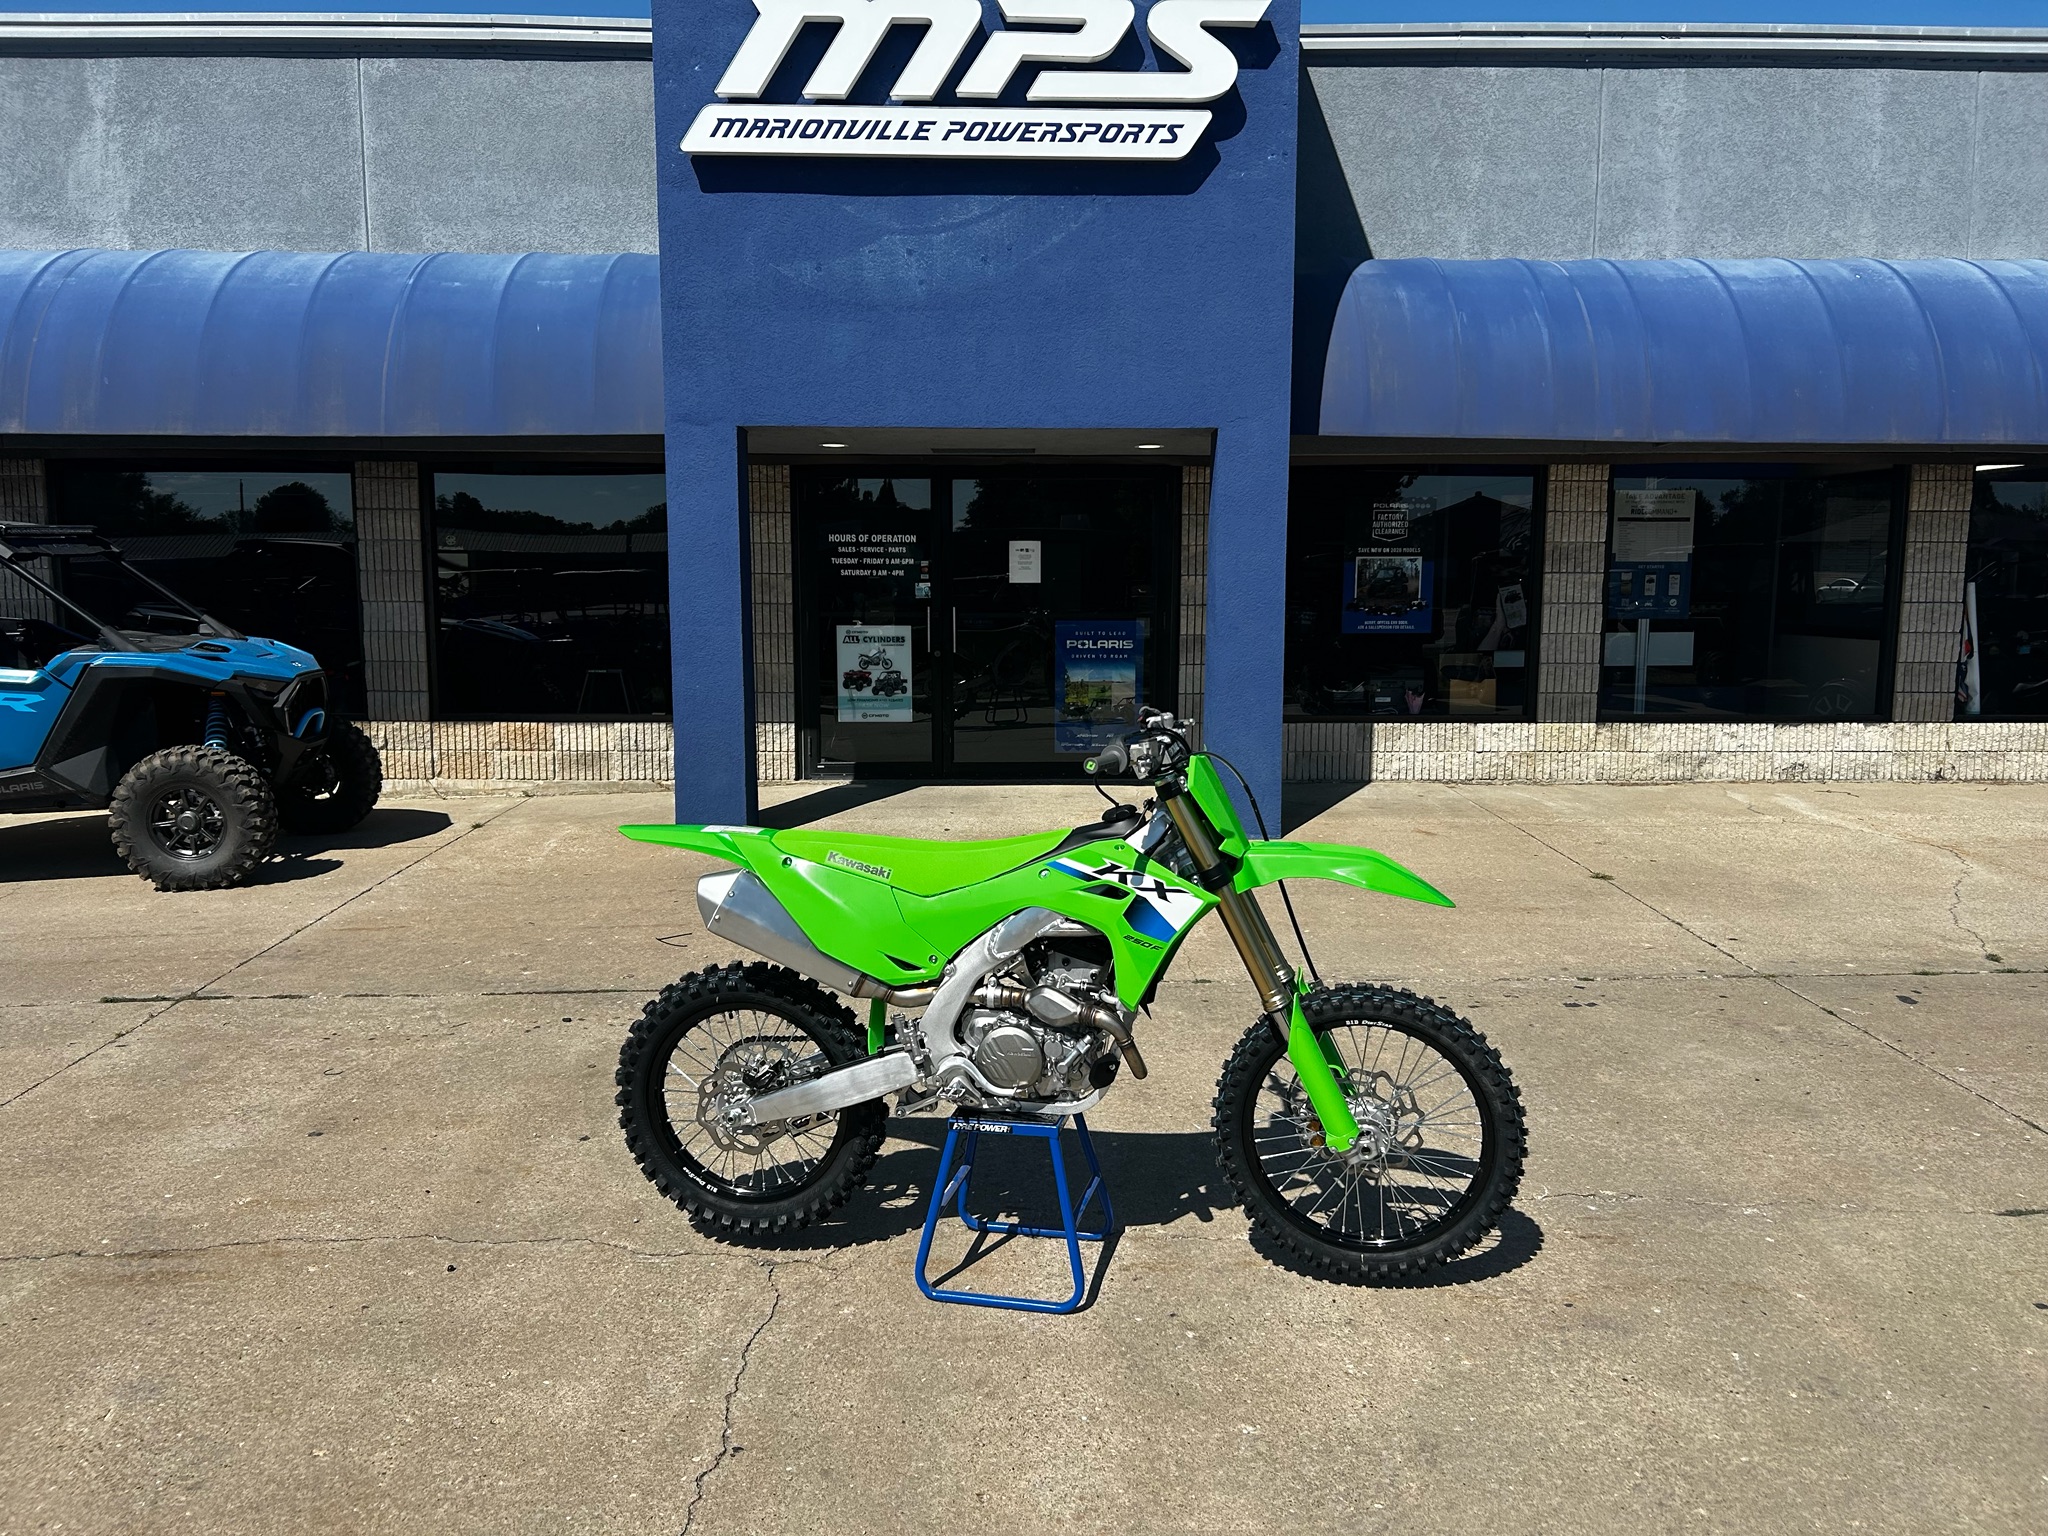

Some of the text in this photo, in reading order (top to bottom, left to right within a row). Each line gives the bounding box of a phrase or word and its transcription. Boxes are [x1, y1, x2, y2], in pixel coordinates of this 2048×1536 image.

[714, 0, 1271, 102] MPS
[709, 118, 1184, 144] MARIONVILLE POWERSPORTS
[1377, 513, 1404, 521] FACTORY
[1372, 520, 1409, 528] AUTHORIZED
[828, 533, 917, 543] HOURS OF OPERATION
[831, 557, 859, 565] TUESDAY
[863, 557, 885, 565] FRIDAY
[885, 557, 890, 565] 9
[840, 569, 871, 577] SATURDAY
[872, 569, 877, 577] 9
[878, 569, 887, 577] AM
[844, 635, 860, 643] ALL
[1066, 639, 1134, 649] POLARIS
[0, 781, 44, 794] LARIS
[827, 851, 892, 880] Kawasaki
[1092, 862, 1190, 904] KX
[1123, 934, 1164, 951] 250F
